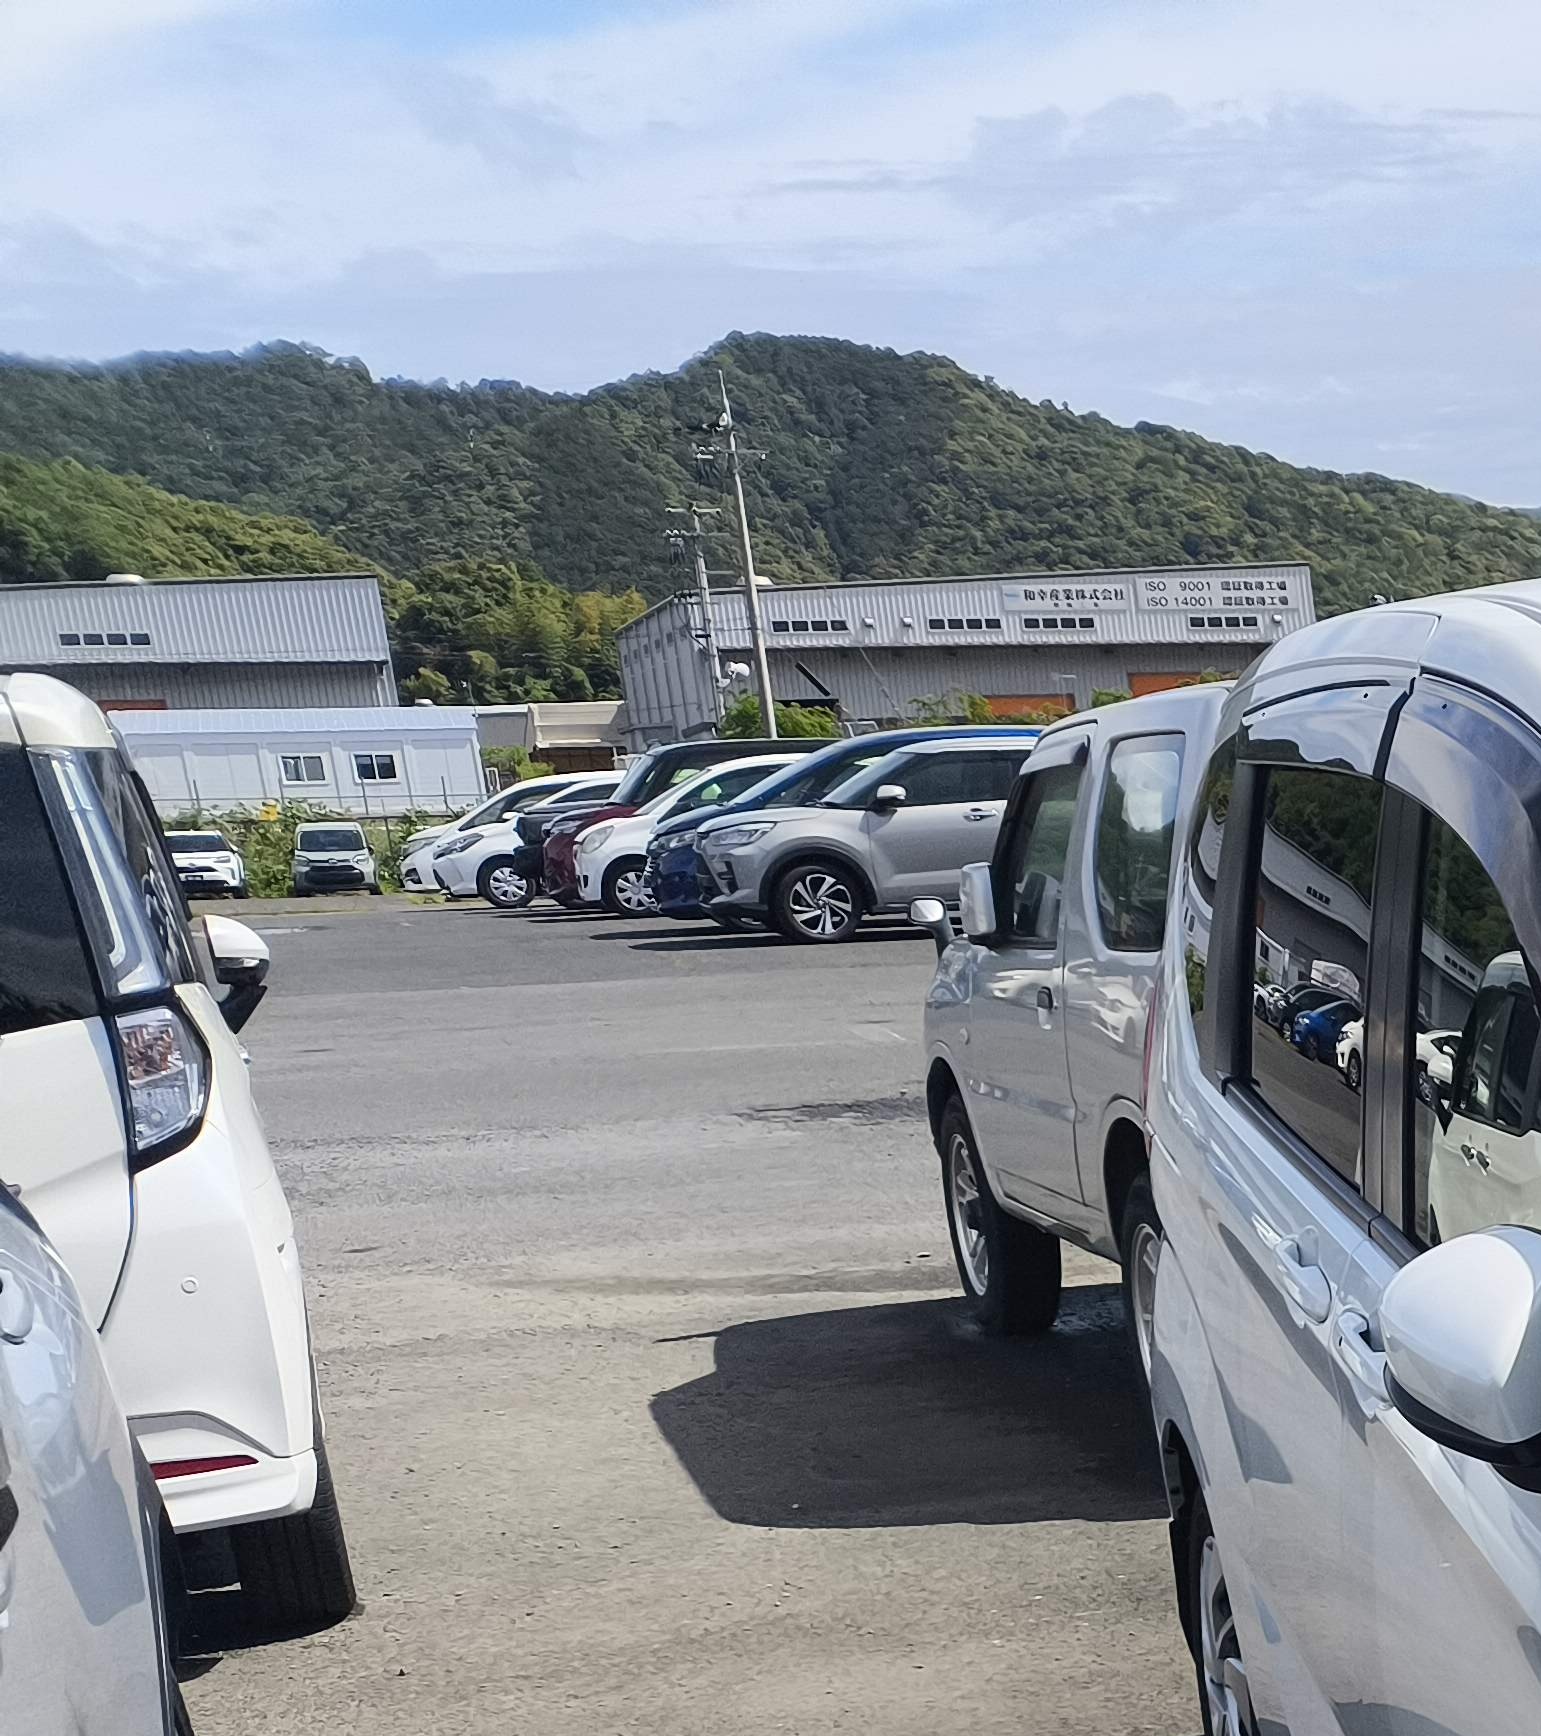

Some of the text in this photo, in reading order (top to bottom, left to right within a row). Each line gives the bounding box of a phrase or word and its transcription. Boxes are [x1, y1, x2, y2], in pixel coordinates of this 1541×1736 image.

[1145, 581, 1167, 592] ISO
[1179, 581, 1211, 592] 9001
[1146, 596, 1169, 607] ISO
[1174, 596, 1213, 607] 14001
